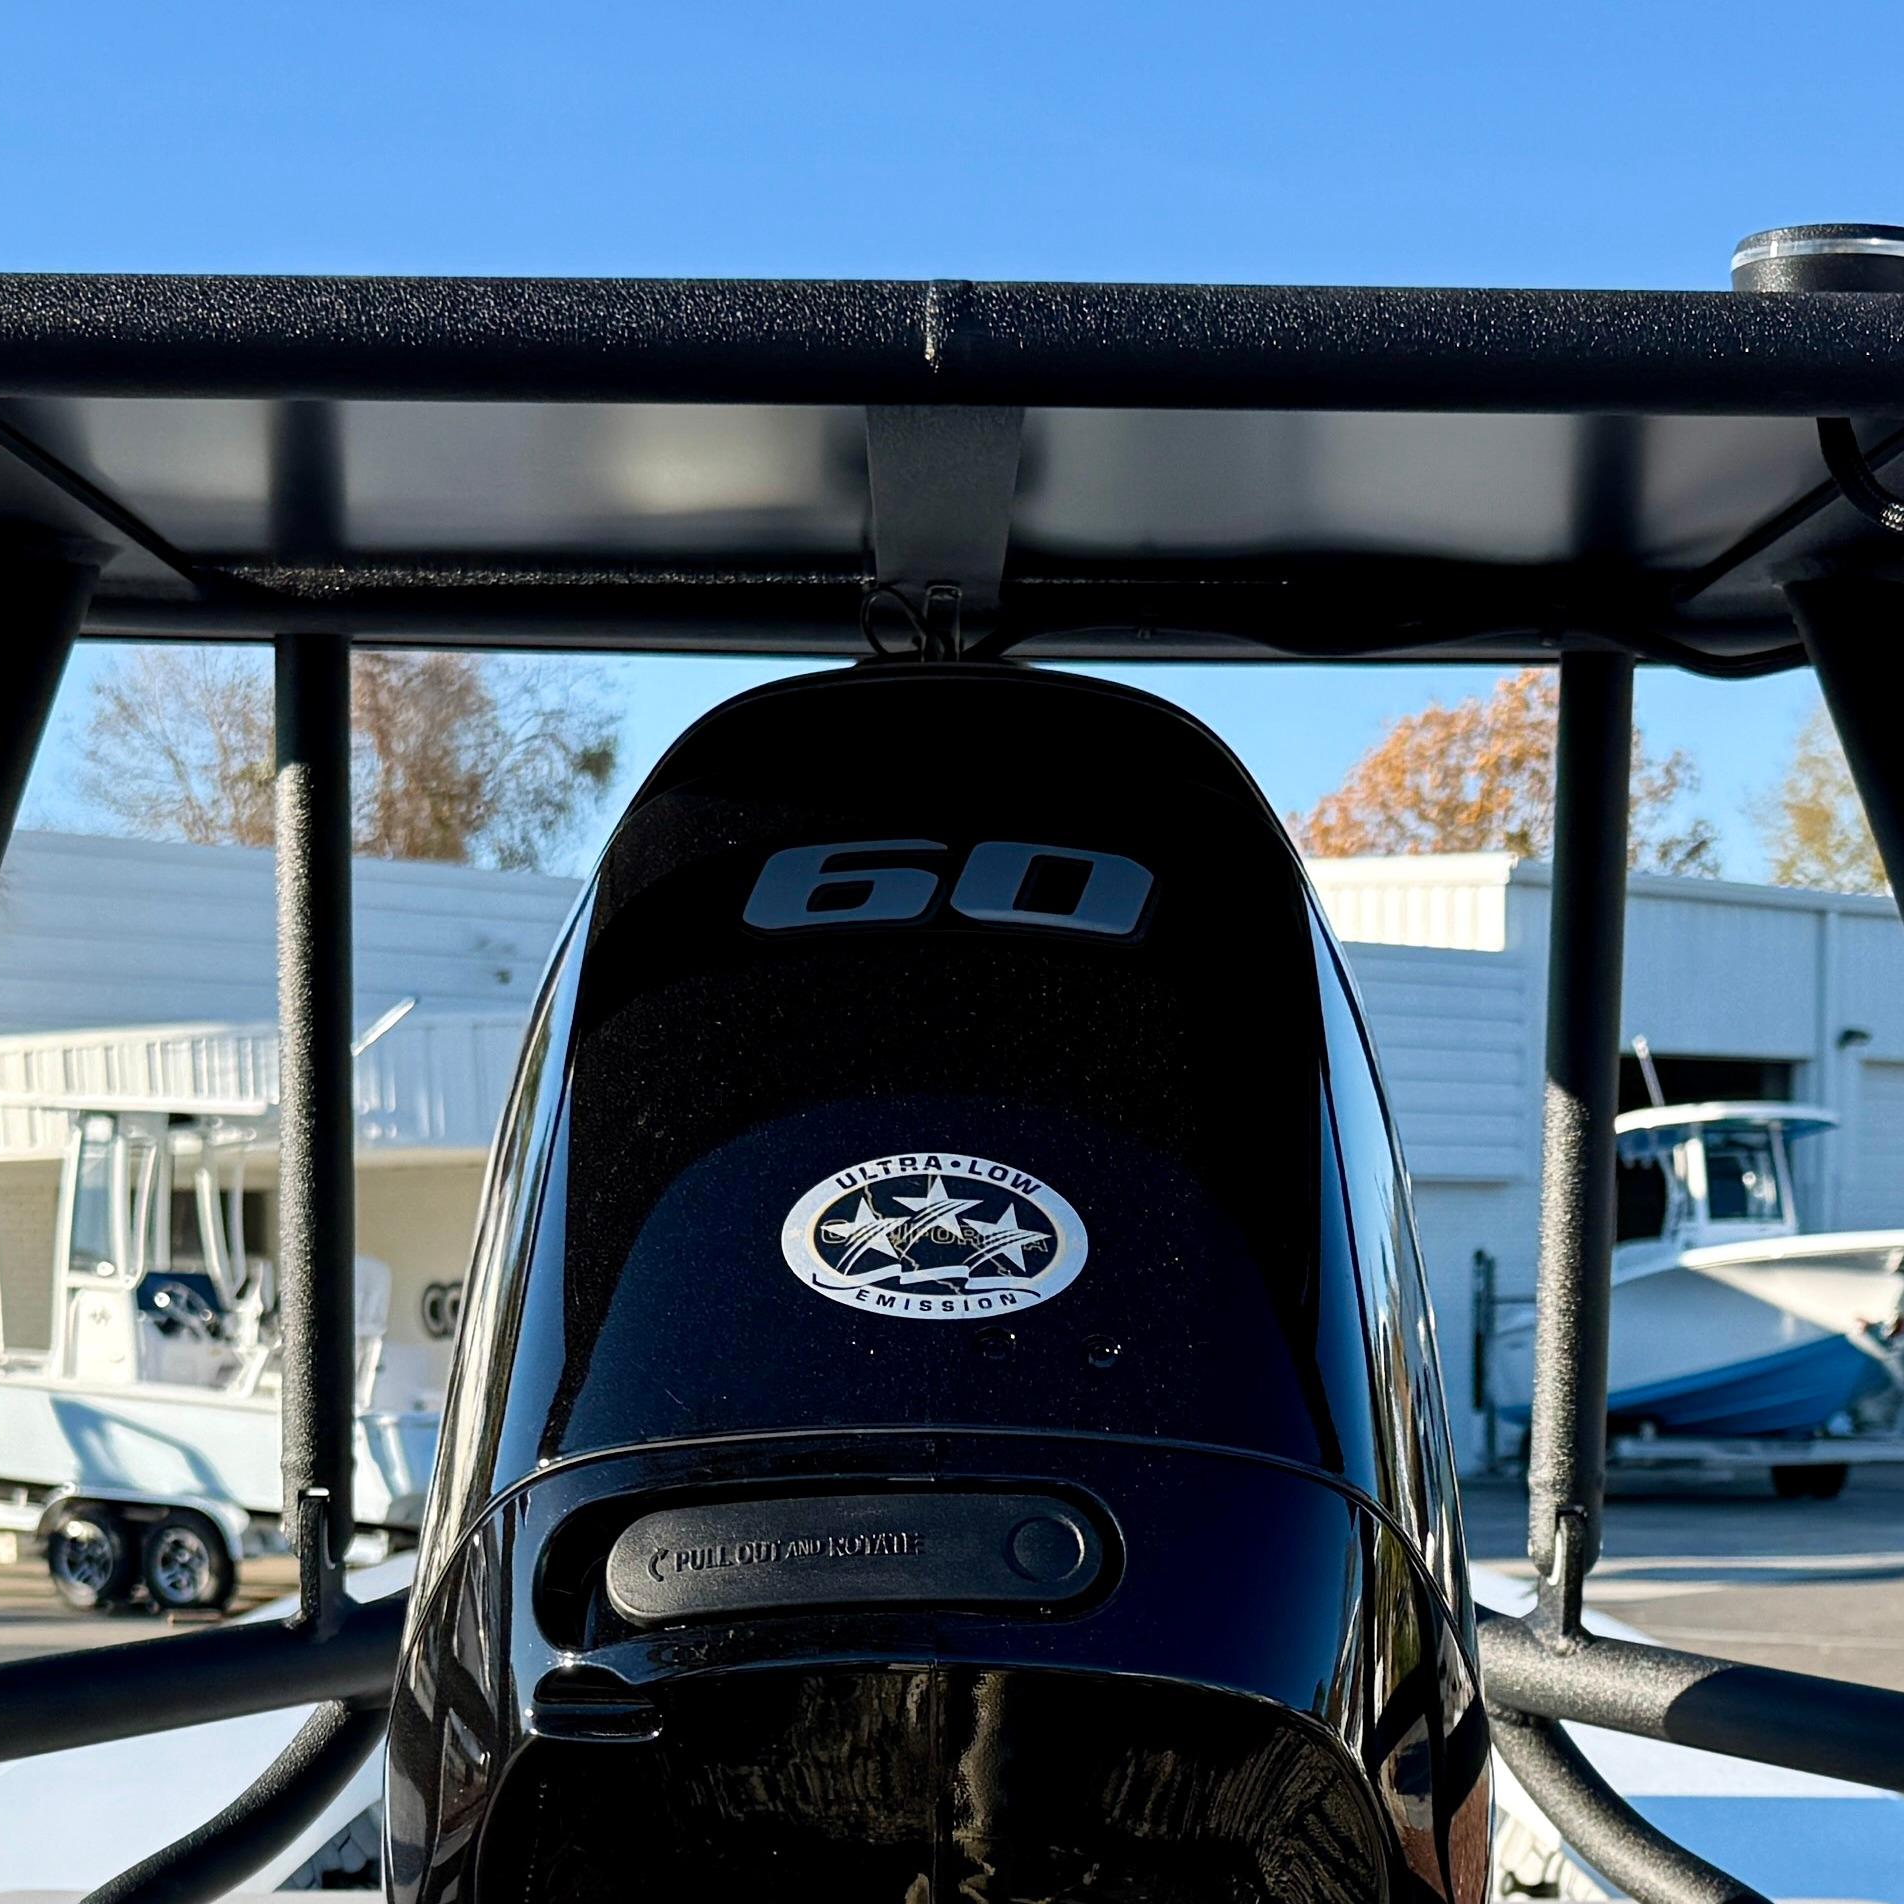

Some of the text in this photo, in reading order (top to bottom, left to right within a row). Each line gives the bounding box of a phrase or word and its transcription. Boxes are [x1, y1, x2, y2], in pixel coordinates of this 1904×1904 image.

[741, 838, 1155, 936] 60
[835, 1154, 1042, 1196] ULTRA LOW
[855, 1287, 1018, 1313] EMISSION
[675, 1531, 928, 1573] PULL OUT AND ROTATE
